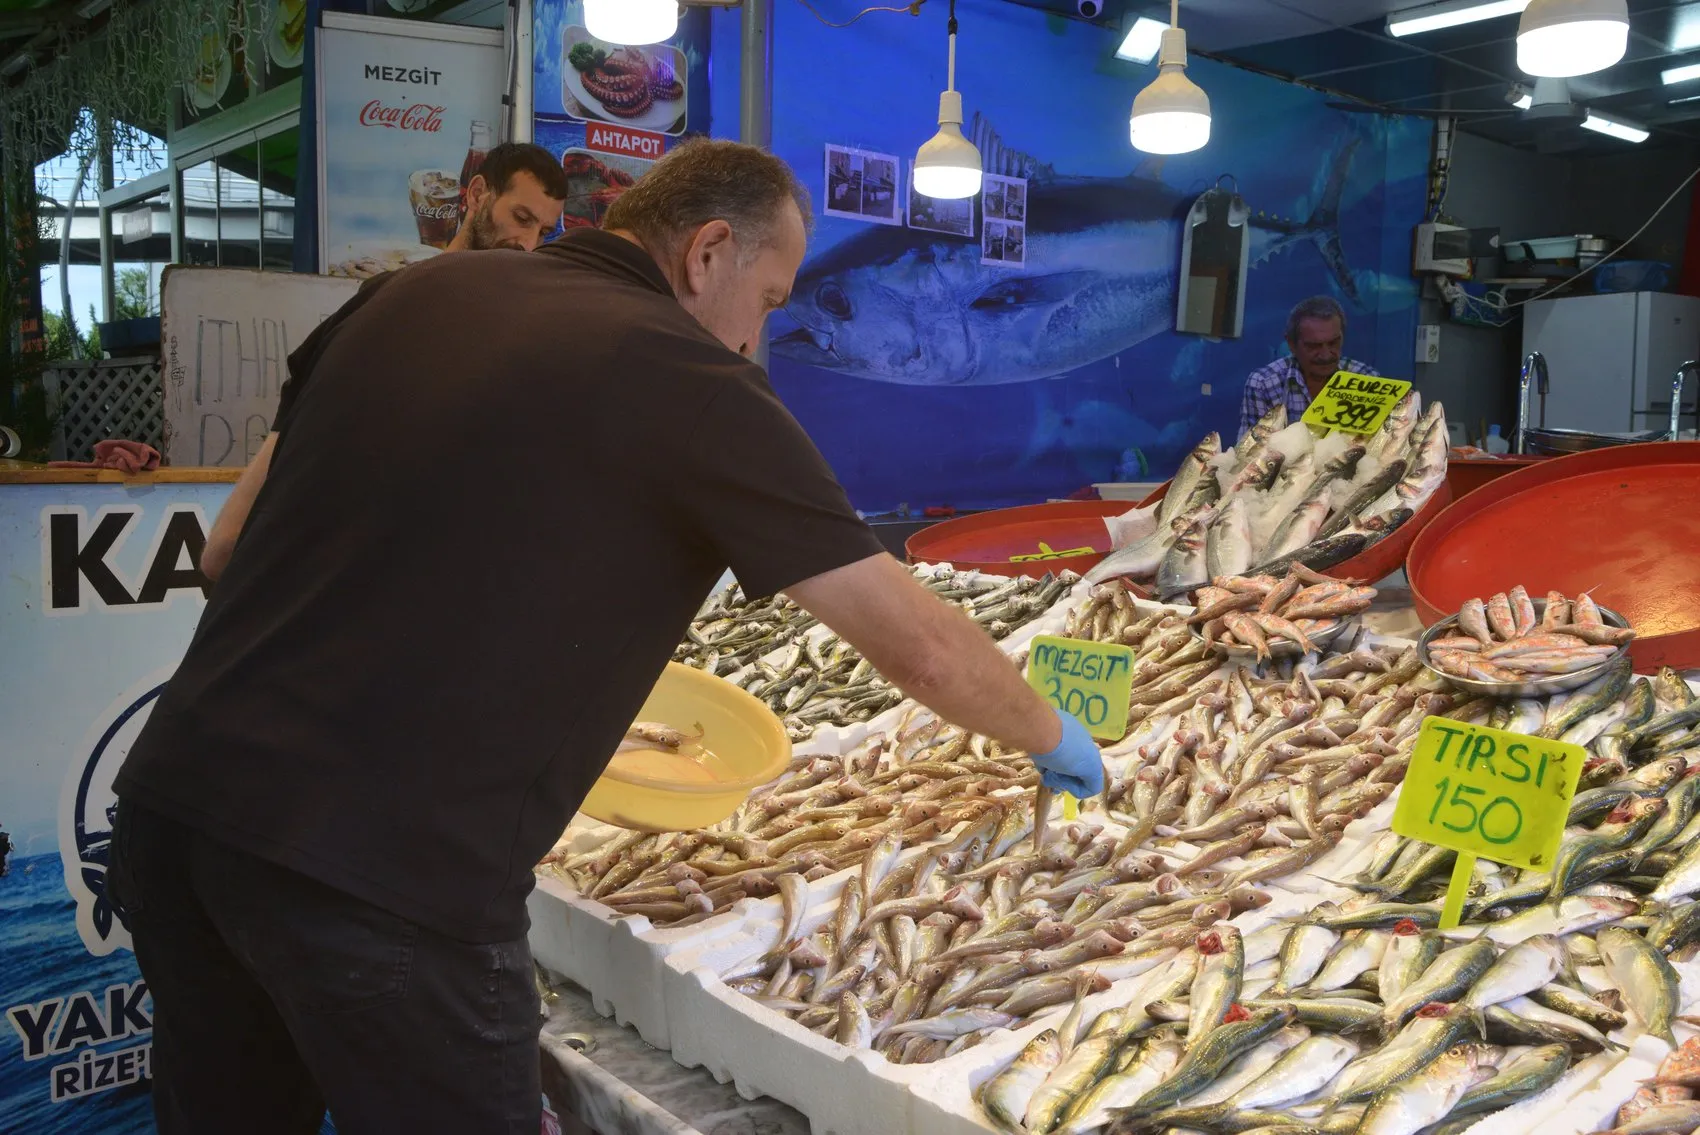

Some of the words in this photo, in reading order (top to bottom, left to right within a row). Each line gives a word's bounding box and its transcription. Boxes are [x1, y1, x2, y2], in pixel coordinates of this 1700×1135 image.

[364, 64, 442, 86] MEZGİT
[590, 129, 661, 155] AHTAPOT
[1321, 400, 1380, 429] 399
[1044, 675, 1108, 726] 300
[1429, 775, 1523, 845] 150
[12, 983, 153, 1056] YAK
[56, 1047, 153, 1098] RİZE'
